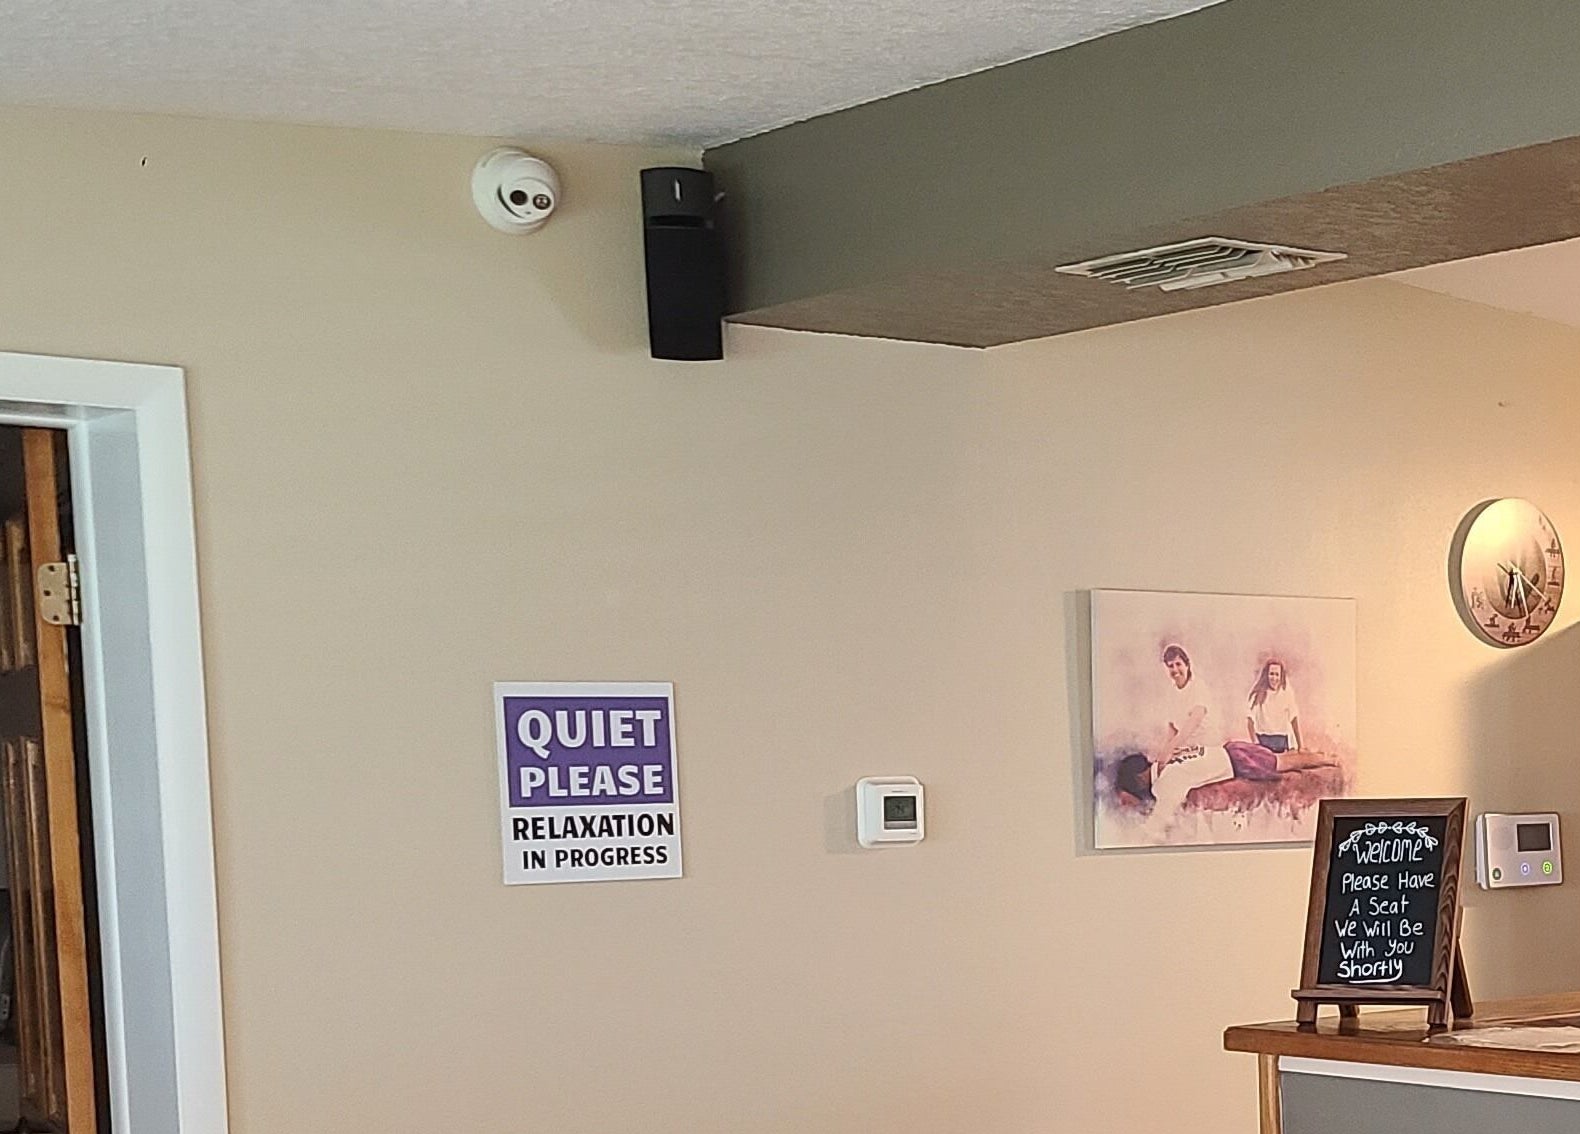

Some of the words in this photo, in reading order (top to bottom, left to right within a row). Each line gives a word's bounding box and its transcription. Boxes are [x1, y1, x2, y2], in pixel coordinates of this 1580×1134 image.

[517, 709, 662, 759] QUIET
[519, 764, 664, 798] PLEASE
[512, 813, 674, 840] RELAXATION
[523, 850, 546, 869] IN
[555, 846, 668, 868] PROGRESS
[1342, 872, 1389, 894] Please
[1398, 871, 1435, 890] Have
[1348, 898, 1360, 917] A
[1368, 894, 1409, 916] Seat
[1334, 919, 1357, 938] We
[1362, 920, 1391, 937] Will
[1399, 918, 1424, 937] Be
[1340, 940, 1375, 959] With
[1337, 958, 1403, 984] Shortly
